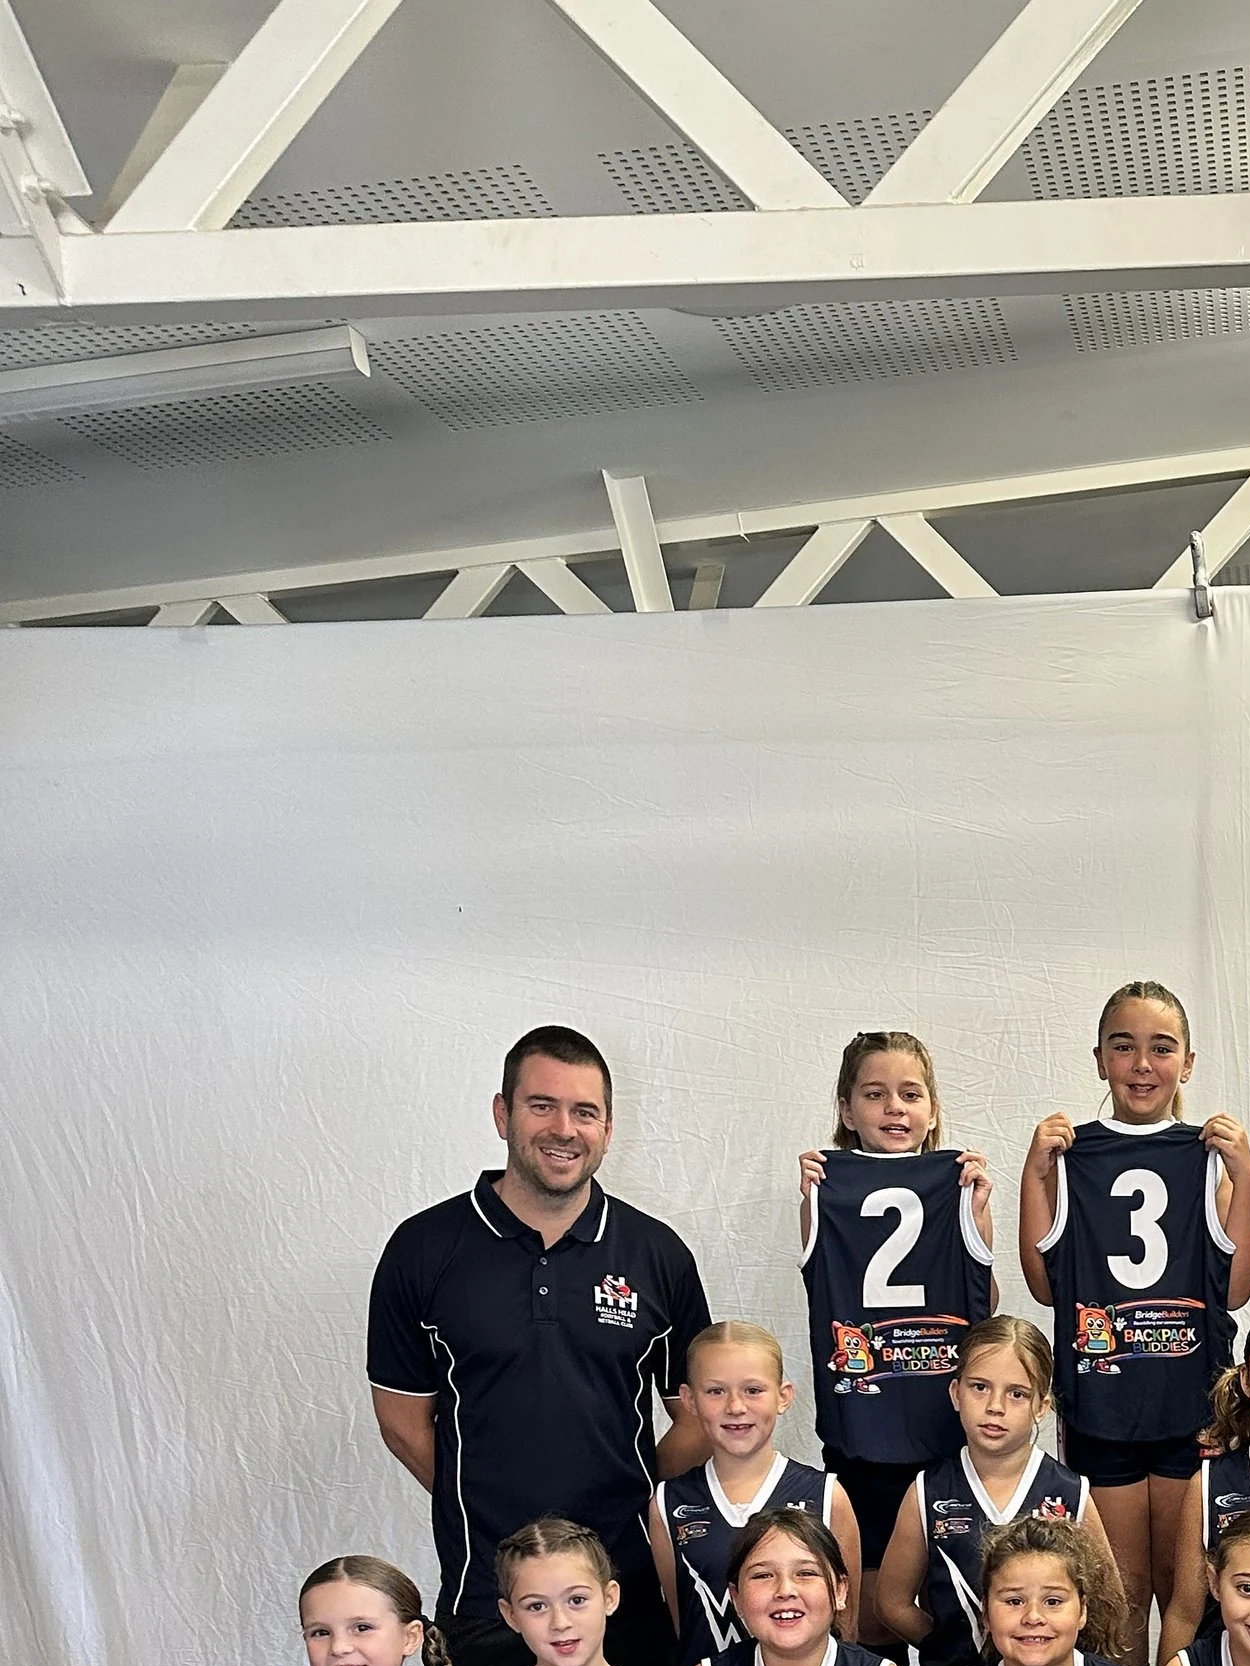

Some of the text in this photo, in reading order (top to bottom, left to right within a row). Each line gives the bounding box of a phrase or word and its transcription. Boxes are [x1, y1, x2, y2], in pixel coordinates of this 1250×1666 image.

[1107, 1169, 1168, 1290] 3
[859, 1187, 925, 1308] 2
[1124, 1328, 1196, 1342] BACKPACK
[882, 1345, 959, 1361] BACKPACK
[1133, 1341, 1189, 1353] BUDDIES
[893, 1359, 951, 1371] BUDDIES
